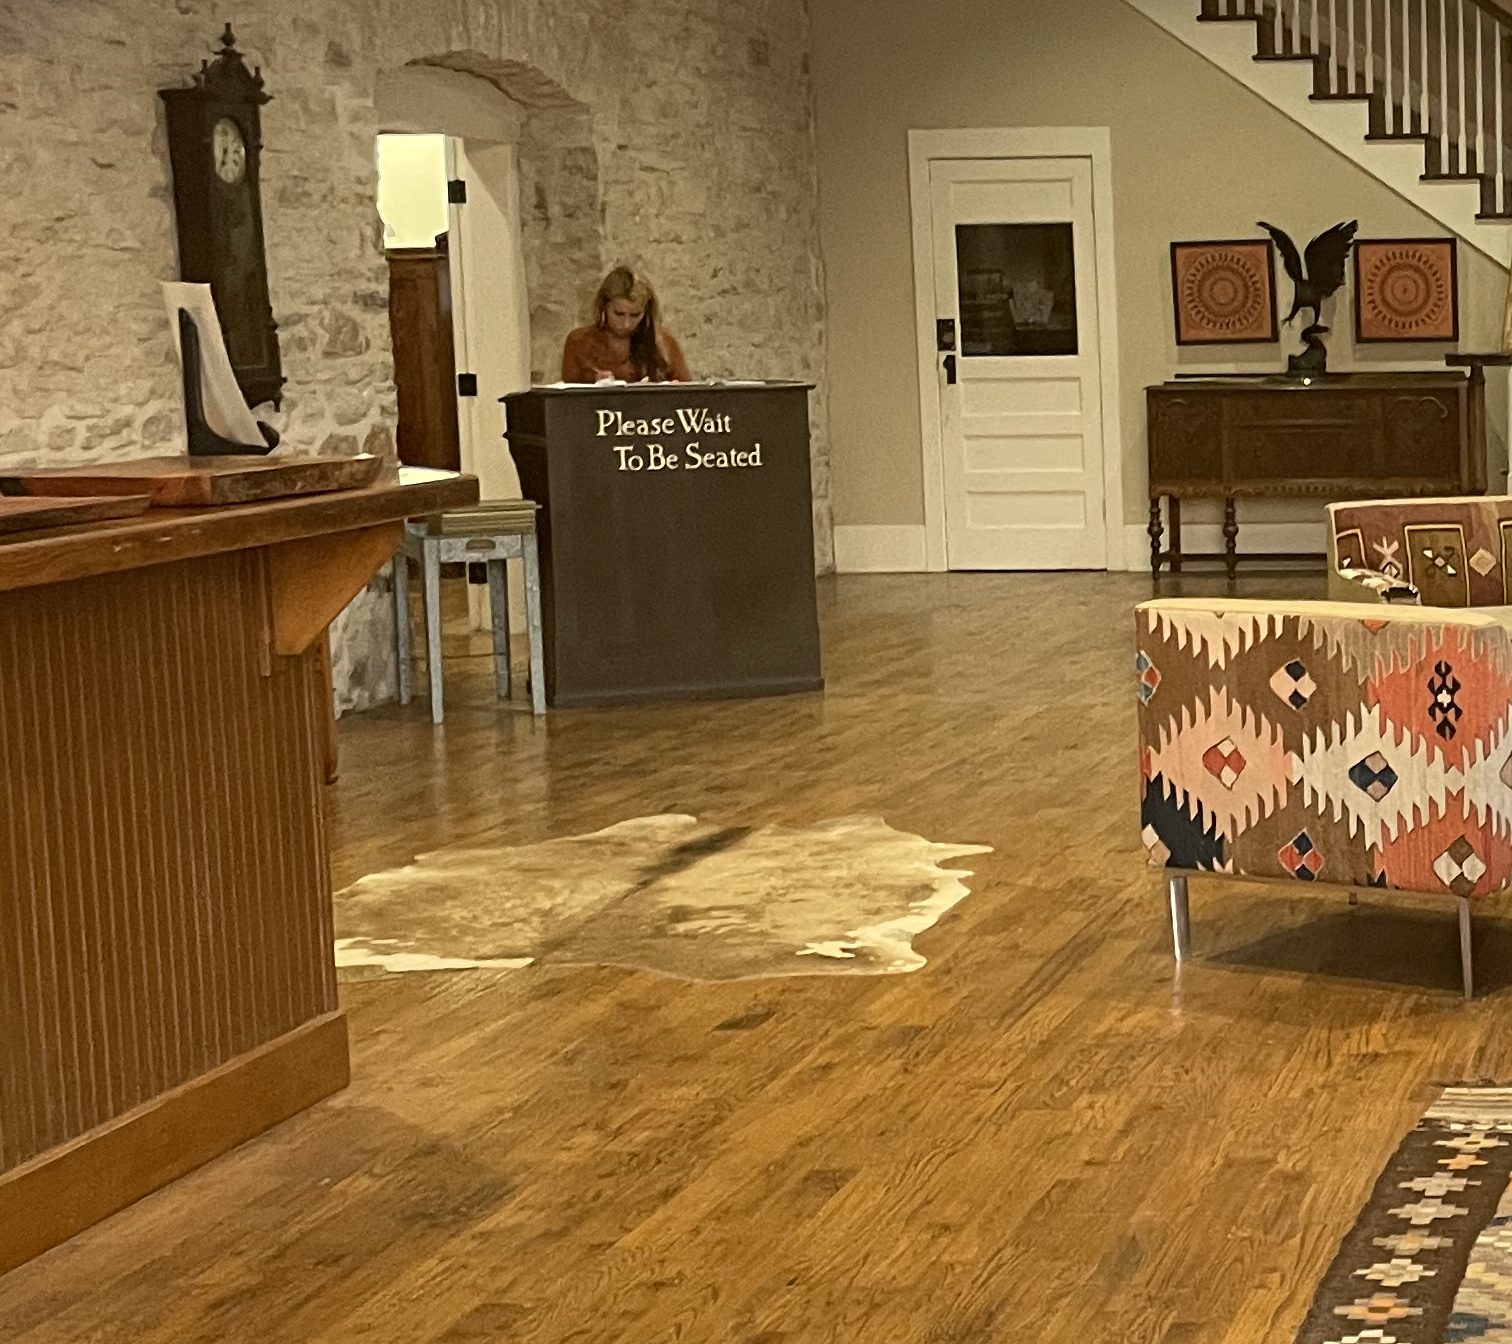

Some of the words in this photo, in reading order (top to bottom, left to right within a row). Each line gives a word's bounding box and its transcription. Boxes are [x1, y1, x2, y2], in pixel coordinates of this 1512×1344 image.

[596, 409, 675, 436] Please
[676, 408, 731, 434] Wait
[613, 445, 644, 471] To
[646, 443, 679, 470] Be
[684, 441, 763, 470] Seated
